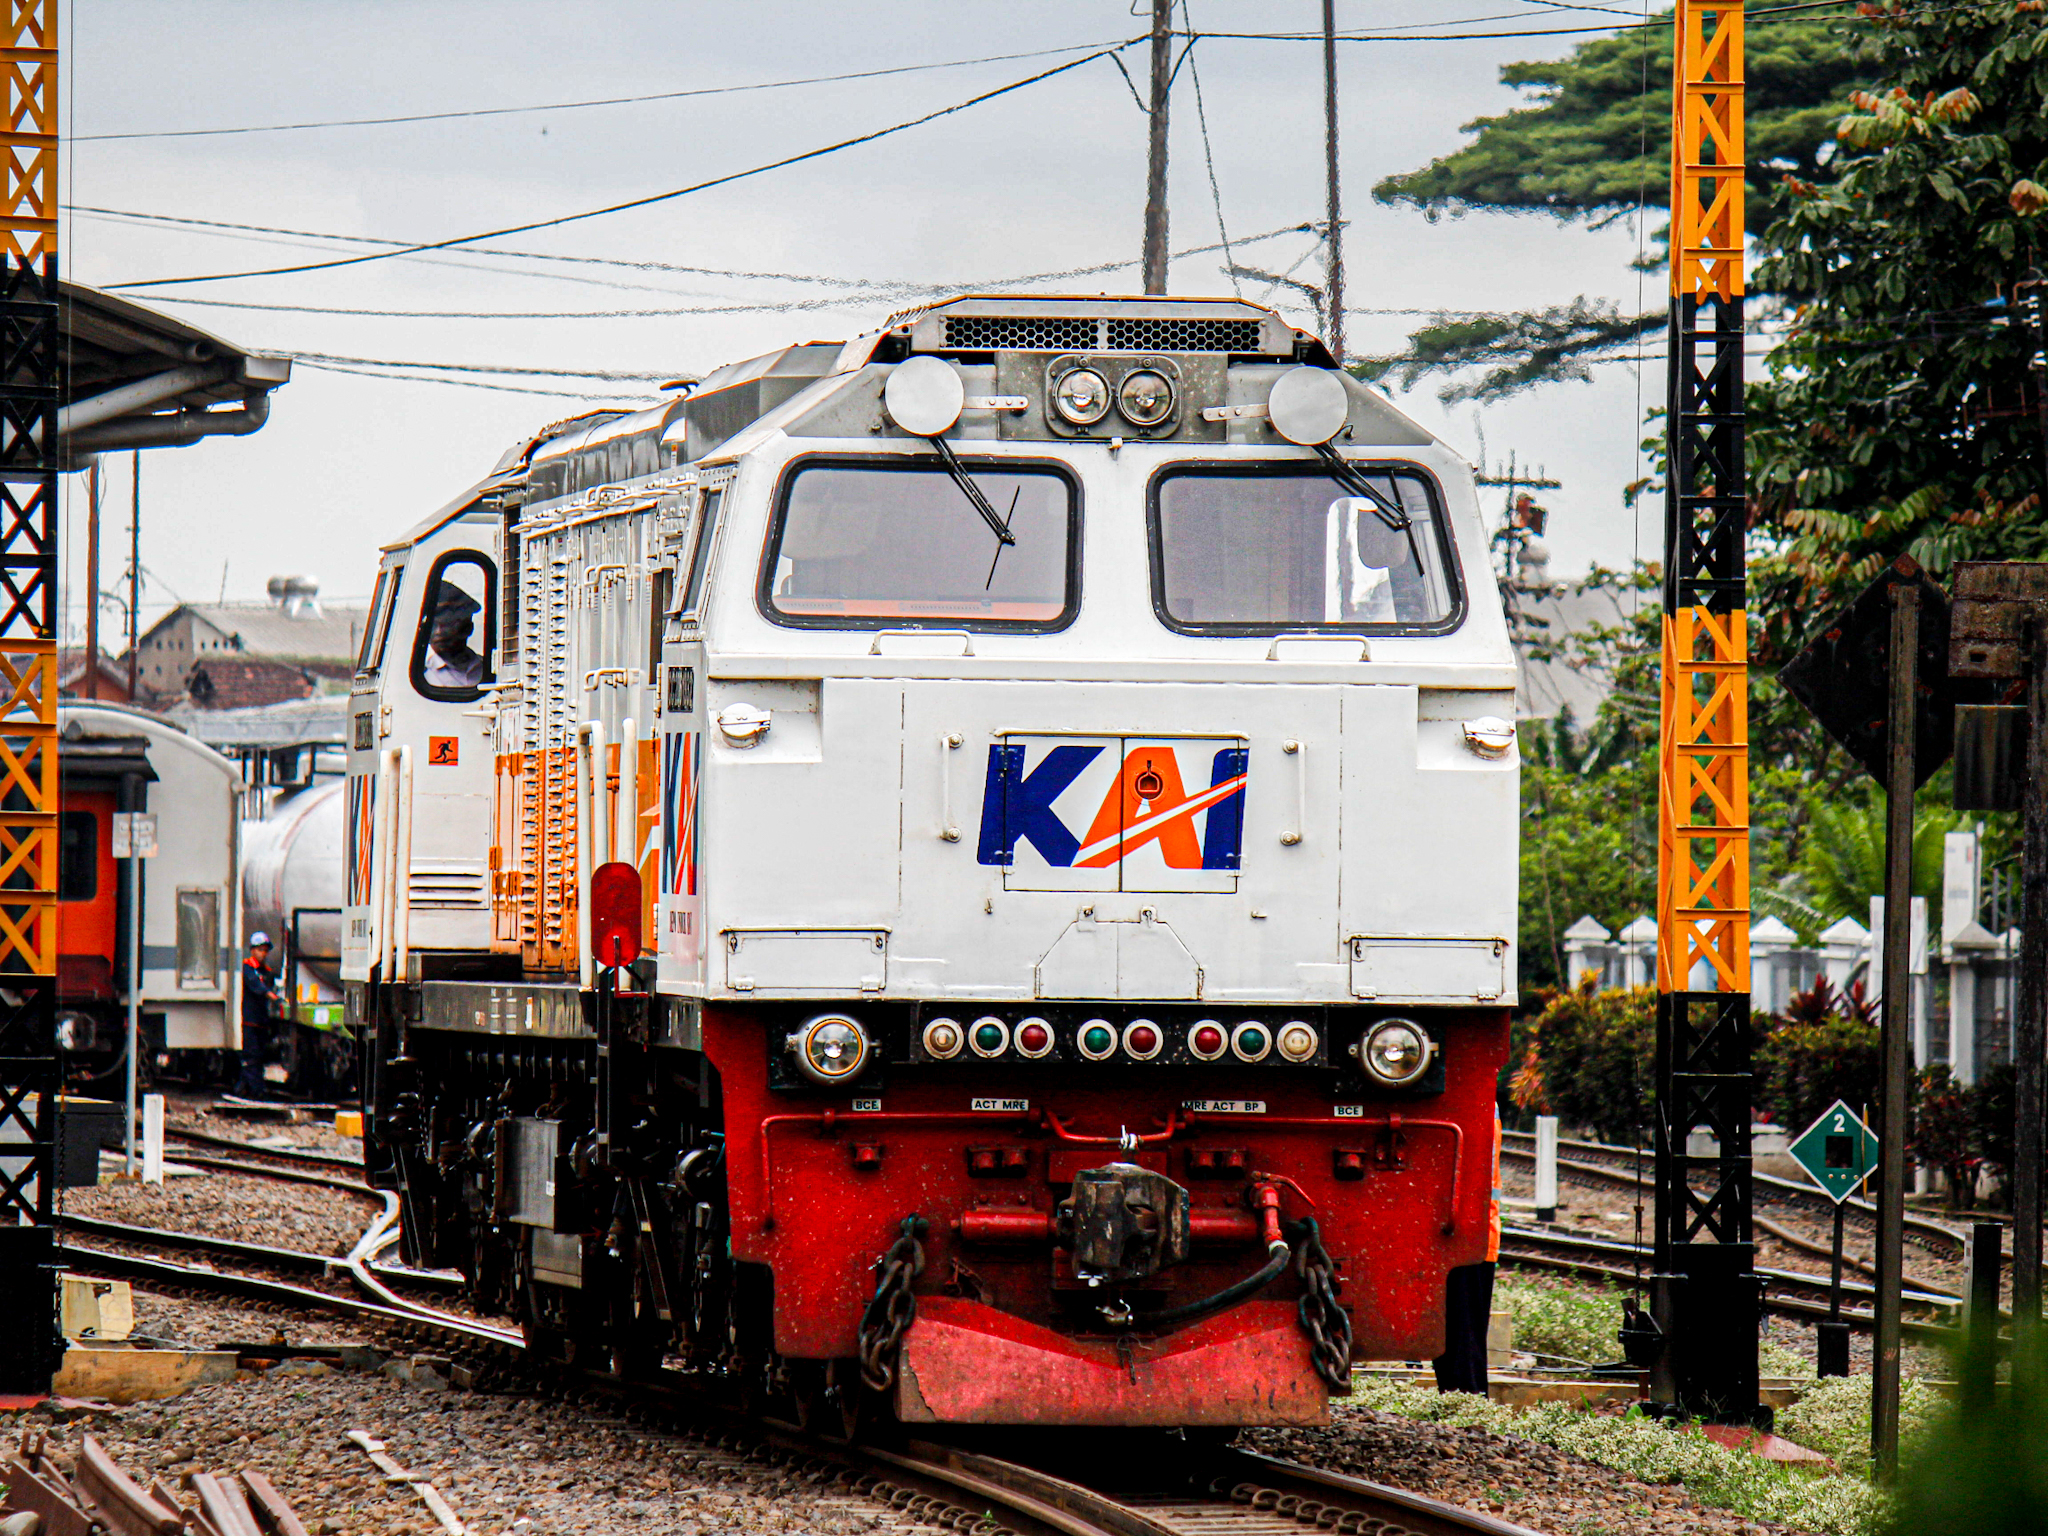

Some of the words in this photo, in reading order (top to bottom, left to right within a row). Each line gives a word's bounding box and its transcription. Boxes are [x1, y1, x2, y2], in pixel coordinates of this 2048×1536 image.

[977, 744, 1249, 870] KAI
[662, 732, 701, 895] KAI
[855, 1100, 879, 1110] BCE
[974, 1100, 997, 1110] ACT
[1002, 1101, 1026, 1111] MRE
[1212, 1102, 1235, 1111] ACT
[1244, 1102, 1259, 1112] BP
[1338, 1106, 1360, 1116] BCE
[1834, 1114, 1845, 1132] 2
